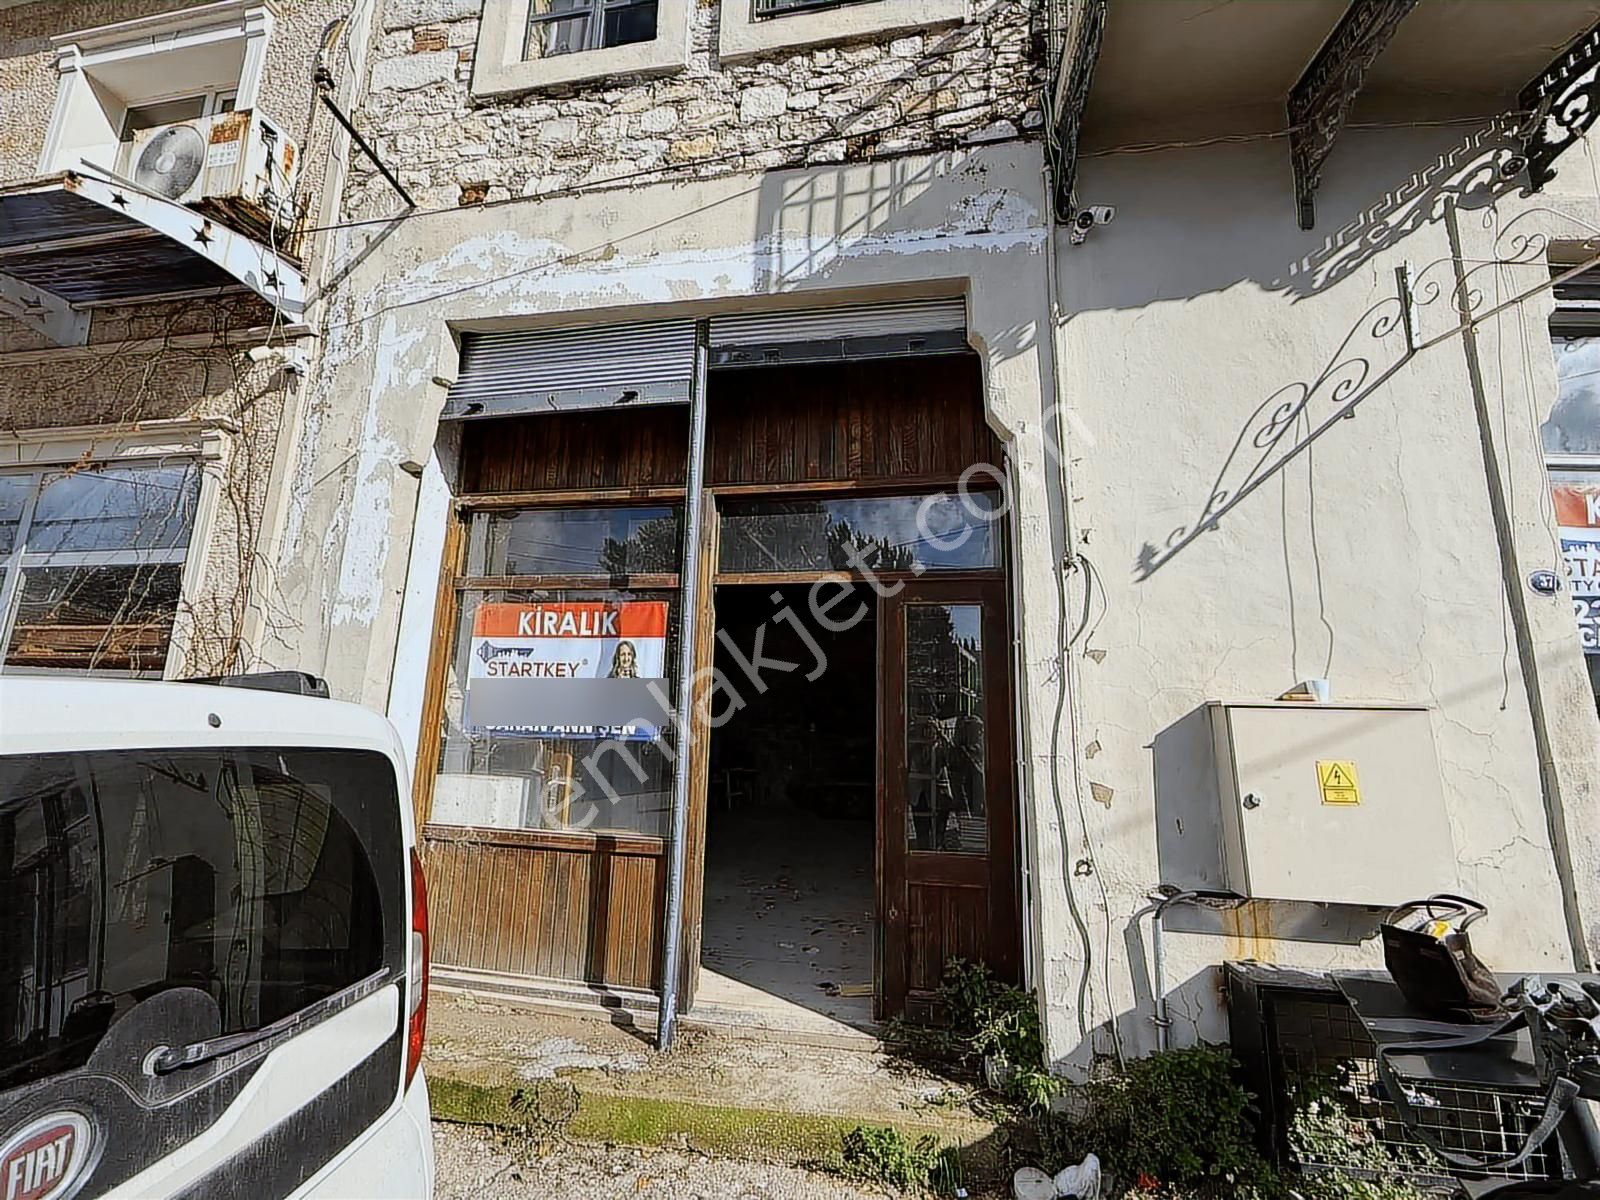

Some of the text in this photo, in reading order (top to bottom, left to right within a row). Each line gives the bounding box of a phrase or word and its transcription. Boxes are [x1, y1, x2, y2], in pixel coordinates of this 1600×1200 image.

[518, 605, 618, 636] KİRALIK
[487, 661, 580, 678] STARTKEY
[6, 1132, 72, 1200] FIAT
